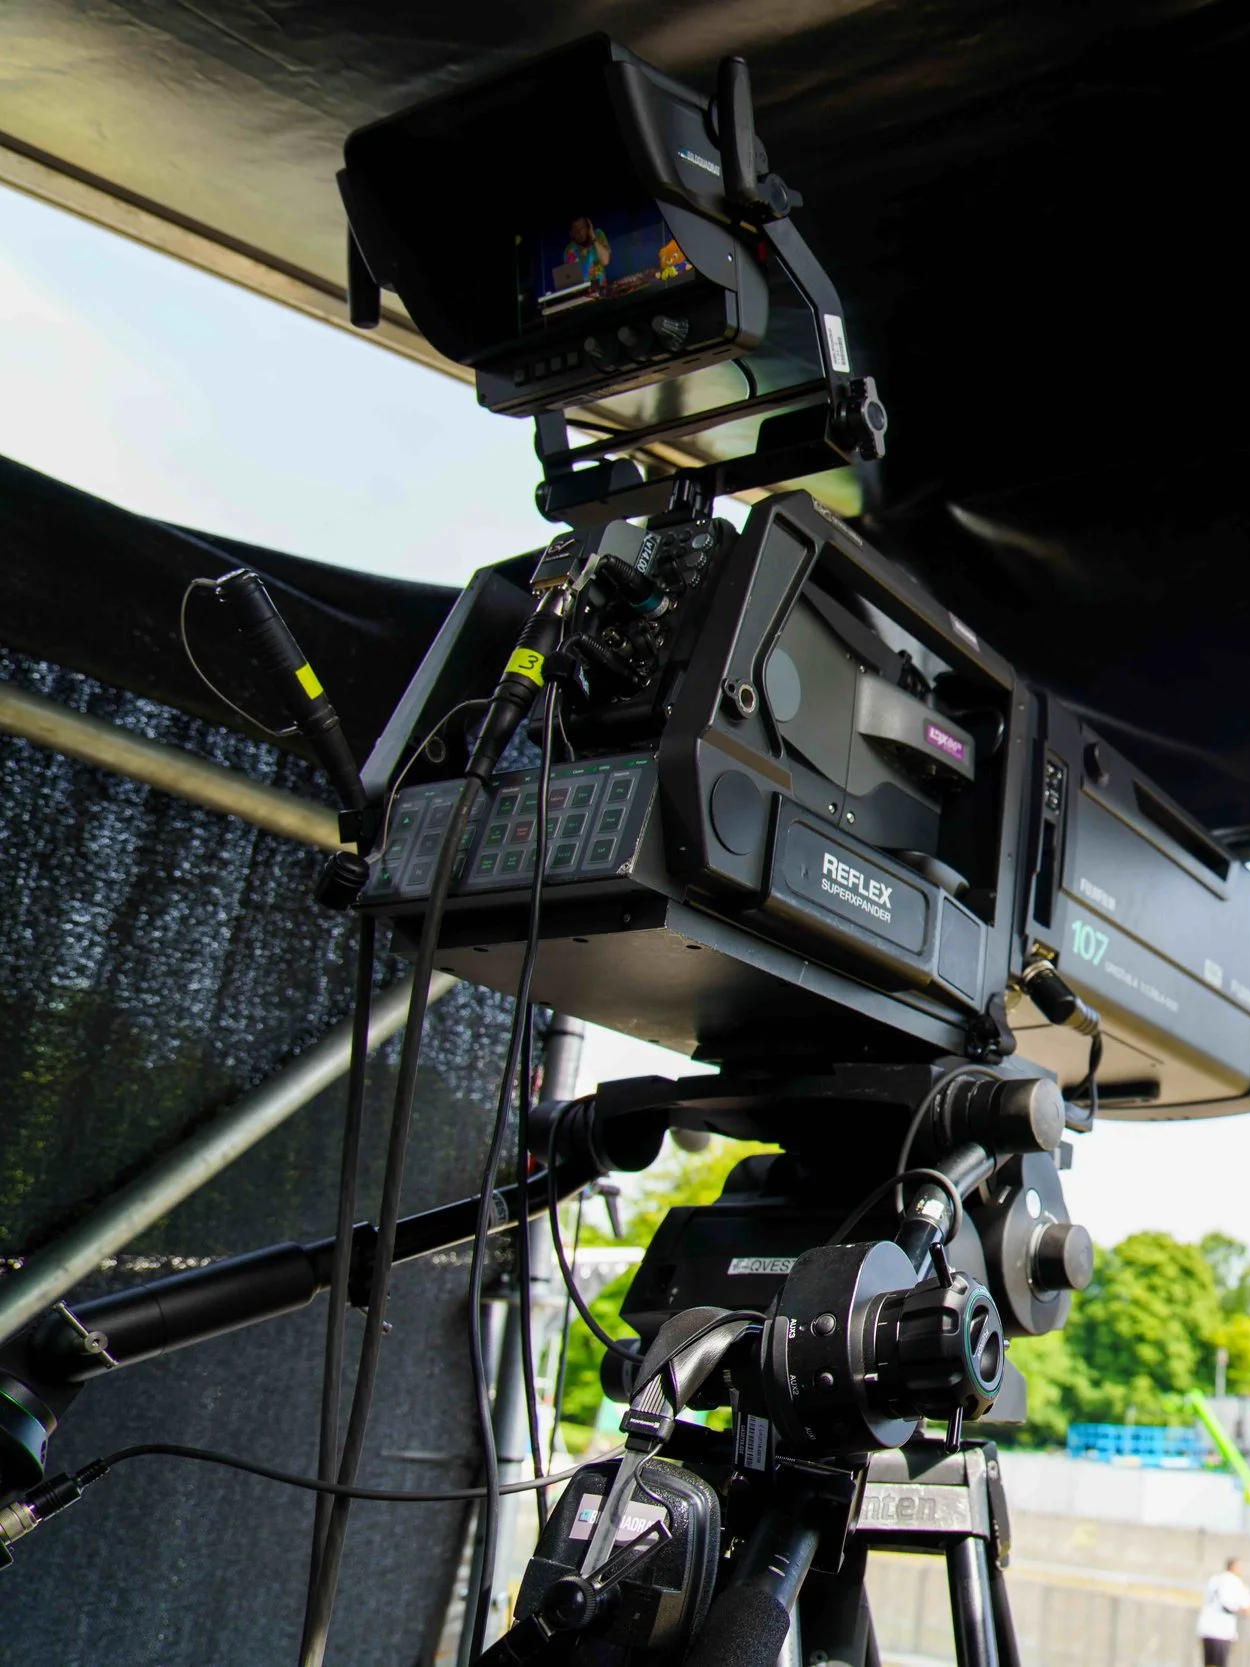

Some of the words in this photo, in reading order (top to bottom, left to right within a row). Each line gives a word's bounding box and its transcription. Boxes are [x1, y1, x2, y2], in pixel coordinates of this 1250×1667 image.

[822, 852, 893, 909] REFLEX
[821, 878, 892, 924] SUPERXPANDER
[1071, 919, 1110, 967] 107
[750, 1258, 798, 1273] QVES
[788, 1318, 798, 1339] AUX3
[789, 1374, 800, 1397] AUX2
[864, 1493, 937, 1522] nten
